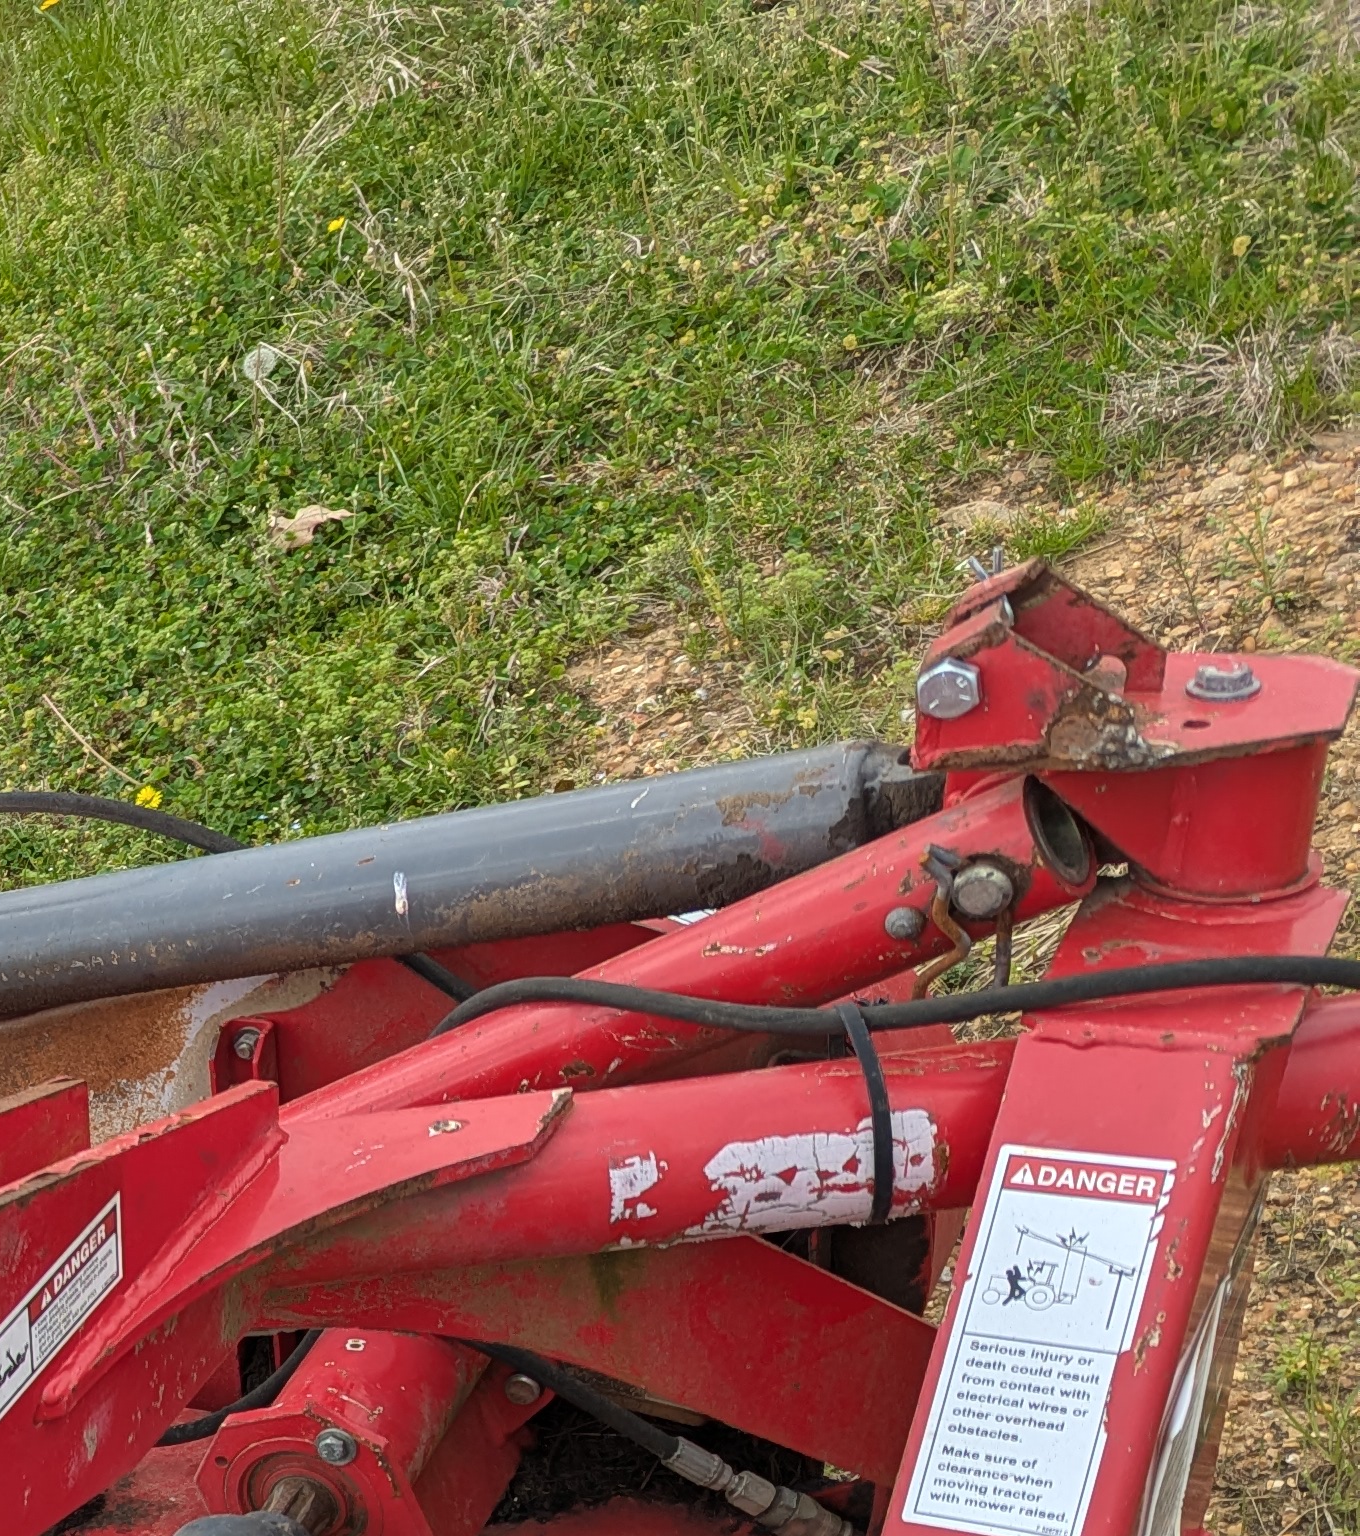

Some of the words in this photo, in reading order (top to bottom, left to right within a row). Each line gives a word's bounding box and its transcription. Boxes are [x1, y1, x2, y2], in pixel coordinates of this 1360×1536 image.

[1036, 1166, 1157, 1198] DANGER
[53, 1223, 106, 1293] DANGER
[970, 1340, 1026, 1356] Serious
[1031, 1348, 1073, 1365] injury
[1078, 1356, 1094, 1366] or
[966, 1357, 1006, 1371] death
[1010, 1364, 1052, 1378] could
[1056, 1371, 1100, 1385] result
[962, 1372, 994, 1386] from
[1000, 1380, 1055, 1396] contact
[1060, 1388, 1090, 1401] with
[956, 1390, 1024, 1408] electrical
[1028, 1400, 1068, 1414] wires
[1072, 1408, 1089, 1417] or
[952, 1406, 991, 1420] other
[995, 1414, 1065, 1432] overhead
[948, 1423, 1023, 1443] obstacles.
[942, 1445, 980, 1460] Make
[984, 1454, 1017, 1466] sure
[1022, 1459, 1038, 1469] of
[937, 1461, 1008, 1481] clearance
[1013, 1472, 1053, 1489] when
[934, 1476, 988, 1496] moving
[993, 1485, 1043, 1503] tractor
[930, 1491, 960, 1504] with
[965, 1498, 1015, 1513] mower
[1019, 1505, 1068, 1523] raised.
